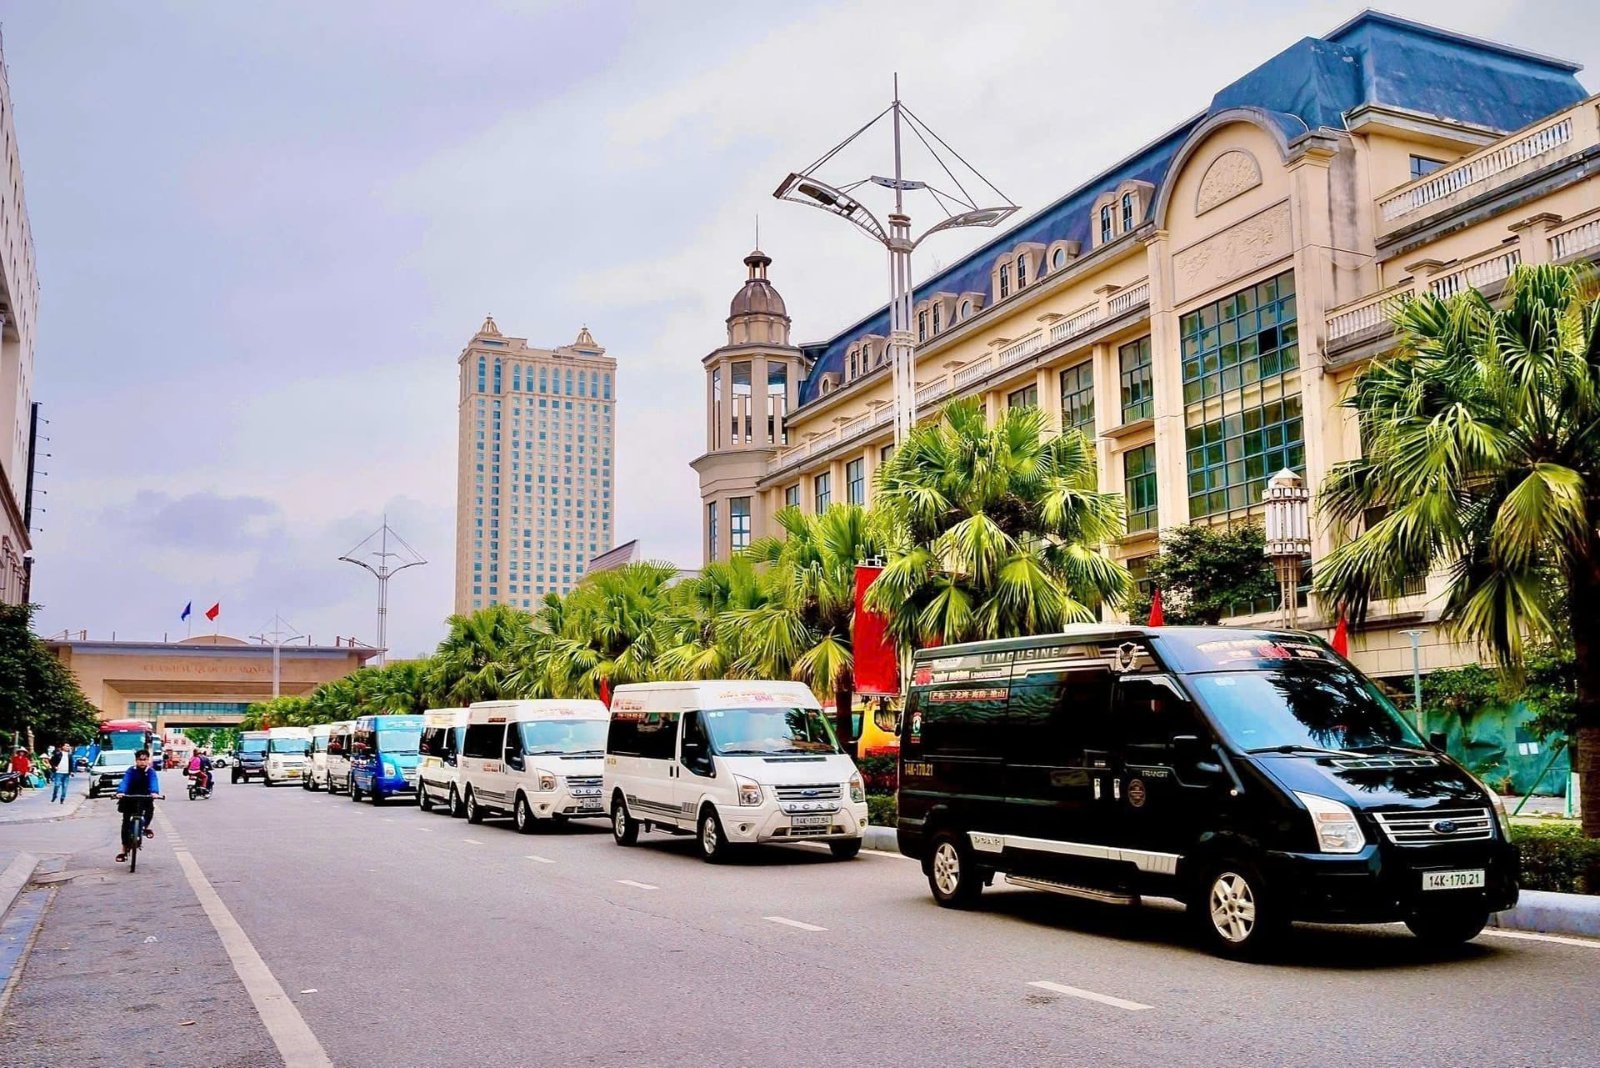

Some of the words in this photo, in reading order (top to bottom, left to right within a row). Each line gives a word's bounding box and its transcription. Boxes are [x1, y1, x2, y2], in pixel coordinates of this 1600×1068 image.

[983, 647, 1060, 664] LIMOUSINE
[904, 763, 934, 776] 14K-170.21
[1429, 873, 1480, 887] 14K-170.21
